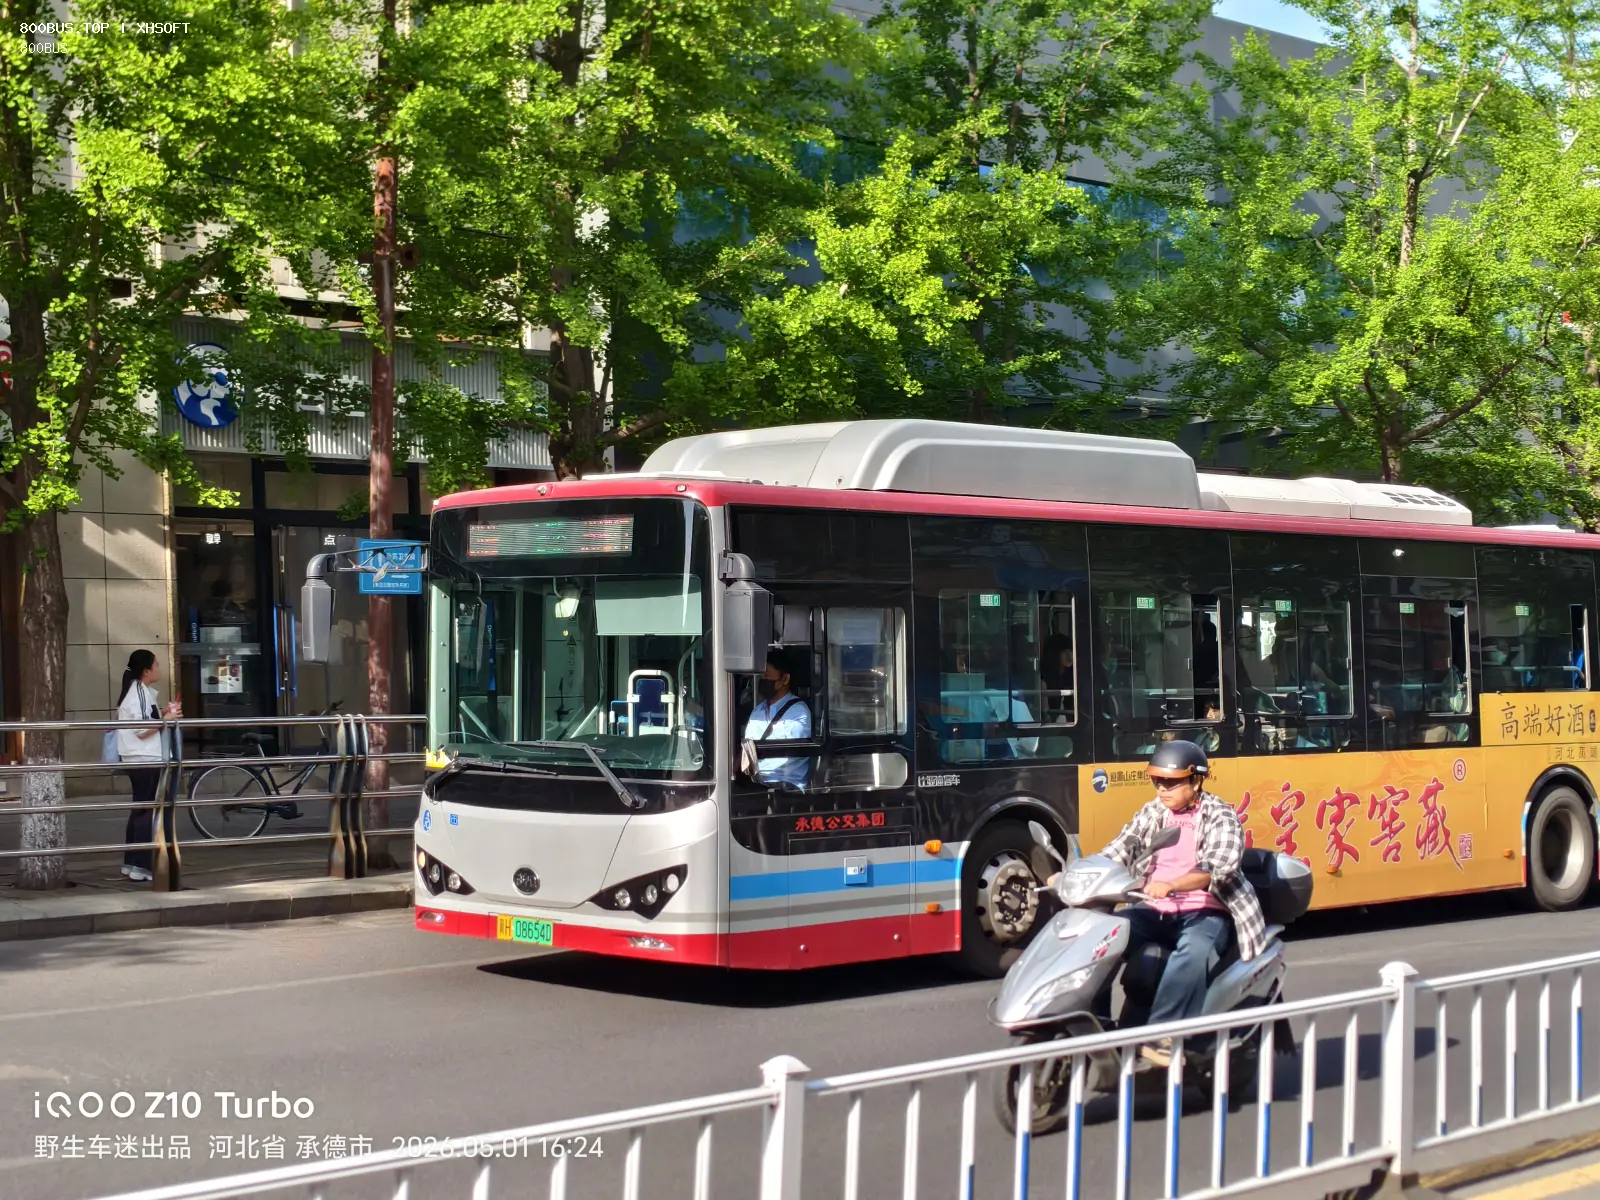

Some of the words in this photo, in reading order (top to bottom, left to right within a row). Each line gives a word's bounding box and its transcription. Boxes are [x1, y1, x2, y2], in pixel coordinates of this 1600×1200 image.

[1501, 701, 1585, 740] 高端好酒
[794, 811, 885, 833] 承德公交集团
